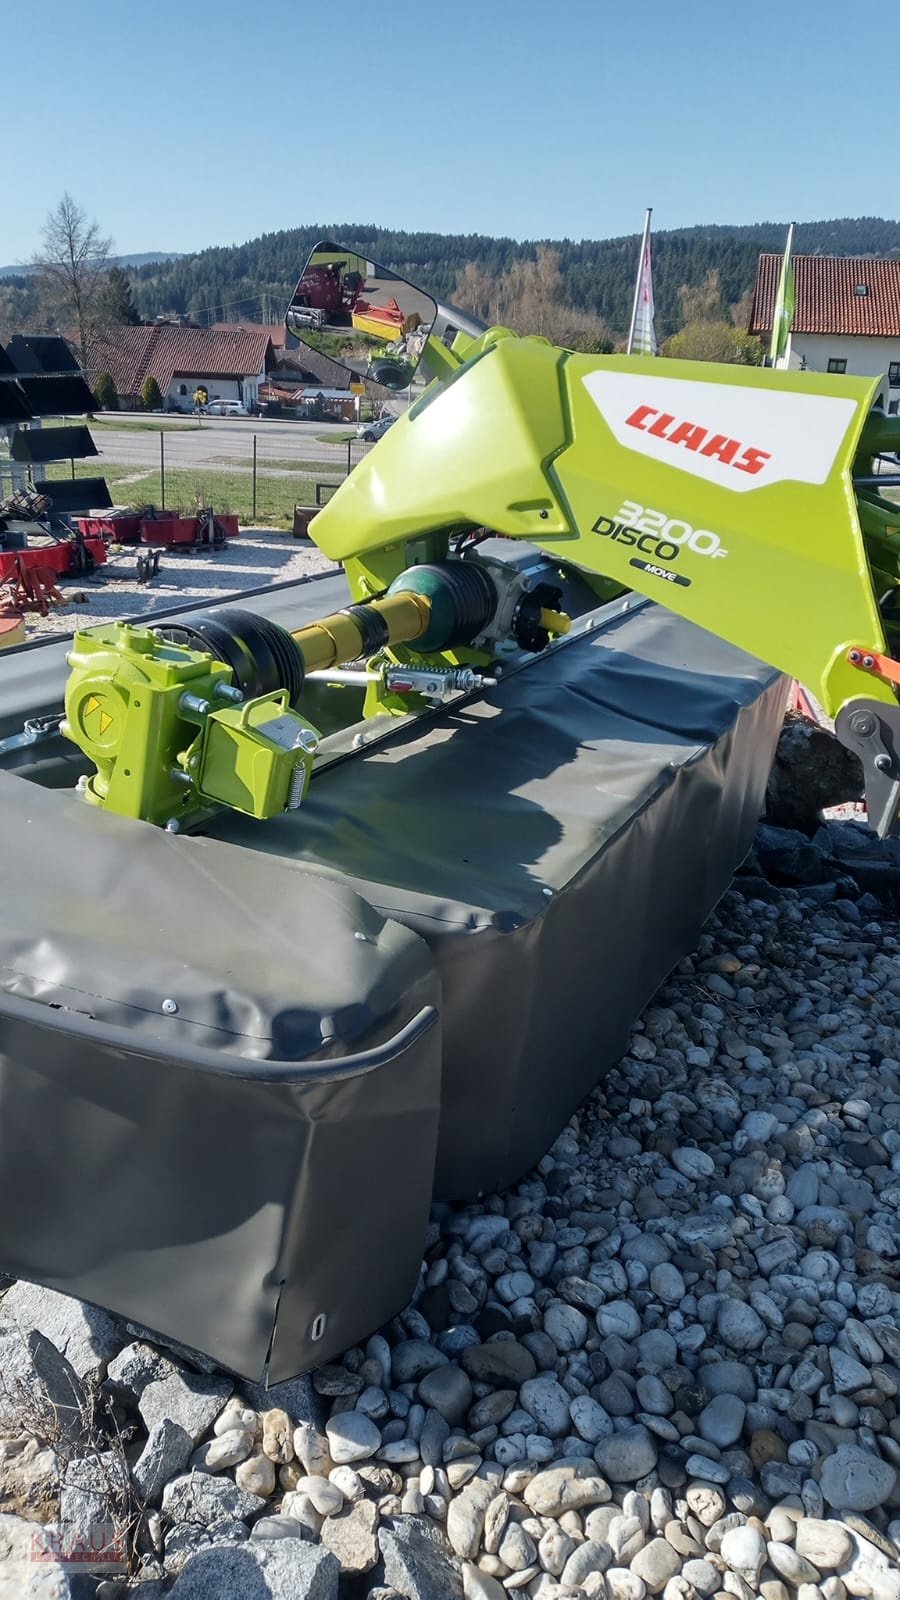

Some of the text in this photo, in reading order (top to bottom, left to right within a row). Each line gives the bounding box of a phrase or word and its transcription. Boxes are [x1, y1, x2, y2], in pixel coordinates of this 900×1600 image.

[625, 405, 773, 475] CLAAS
[591, 516, 680, 561] DISCO
[644, 563, 677, 582] MOVE
